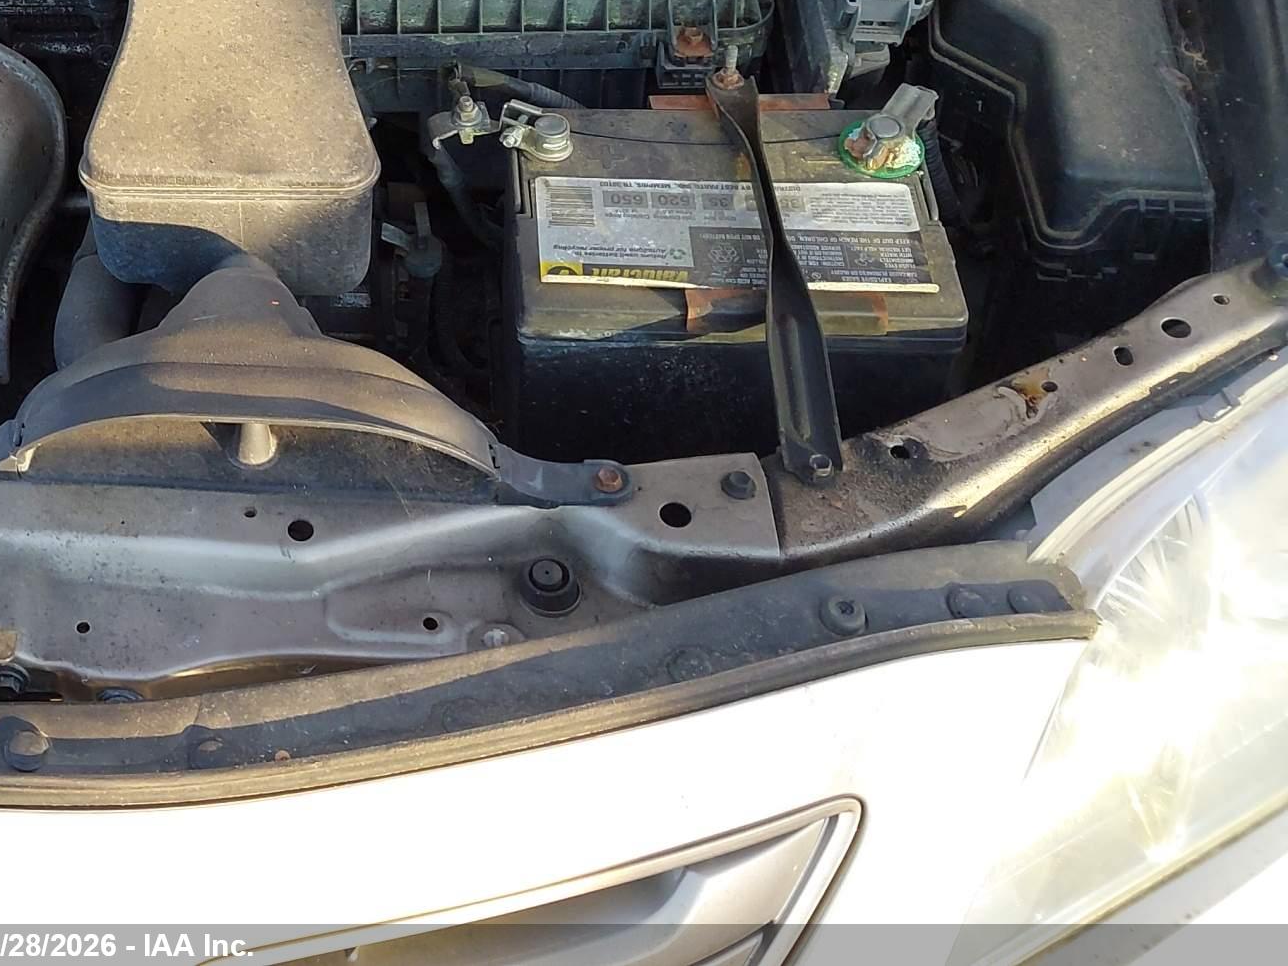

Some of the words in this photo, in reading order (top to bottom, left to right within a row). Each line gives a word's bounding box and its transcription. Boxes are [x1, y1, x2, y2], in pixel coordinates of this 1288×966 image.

[610, 193, 643, 206] 650
[658, 194, 691, 206] 620
[553, 244, 587, 252] recycling
